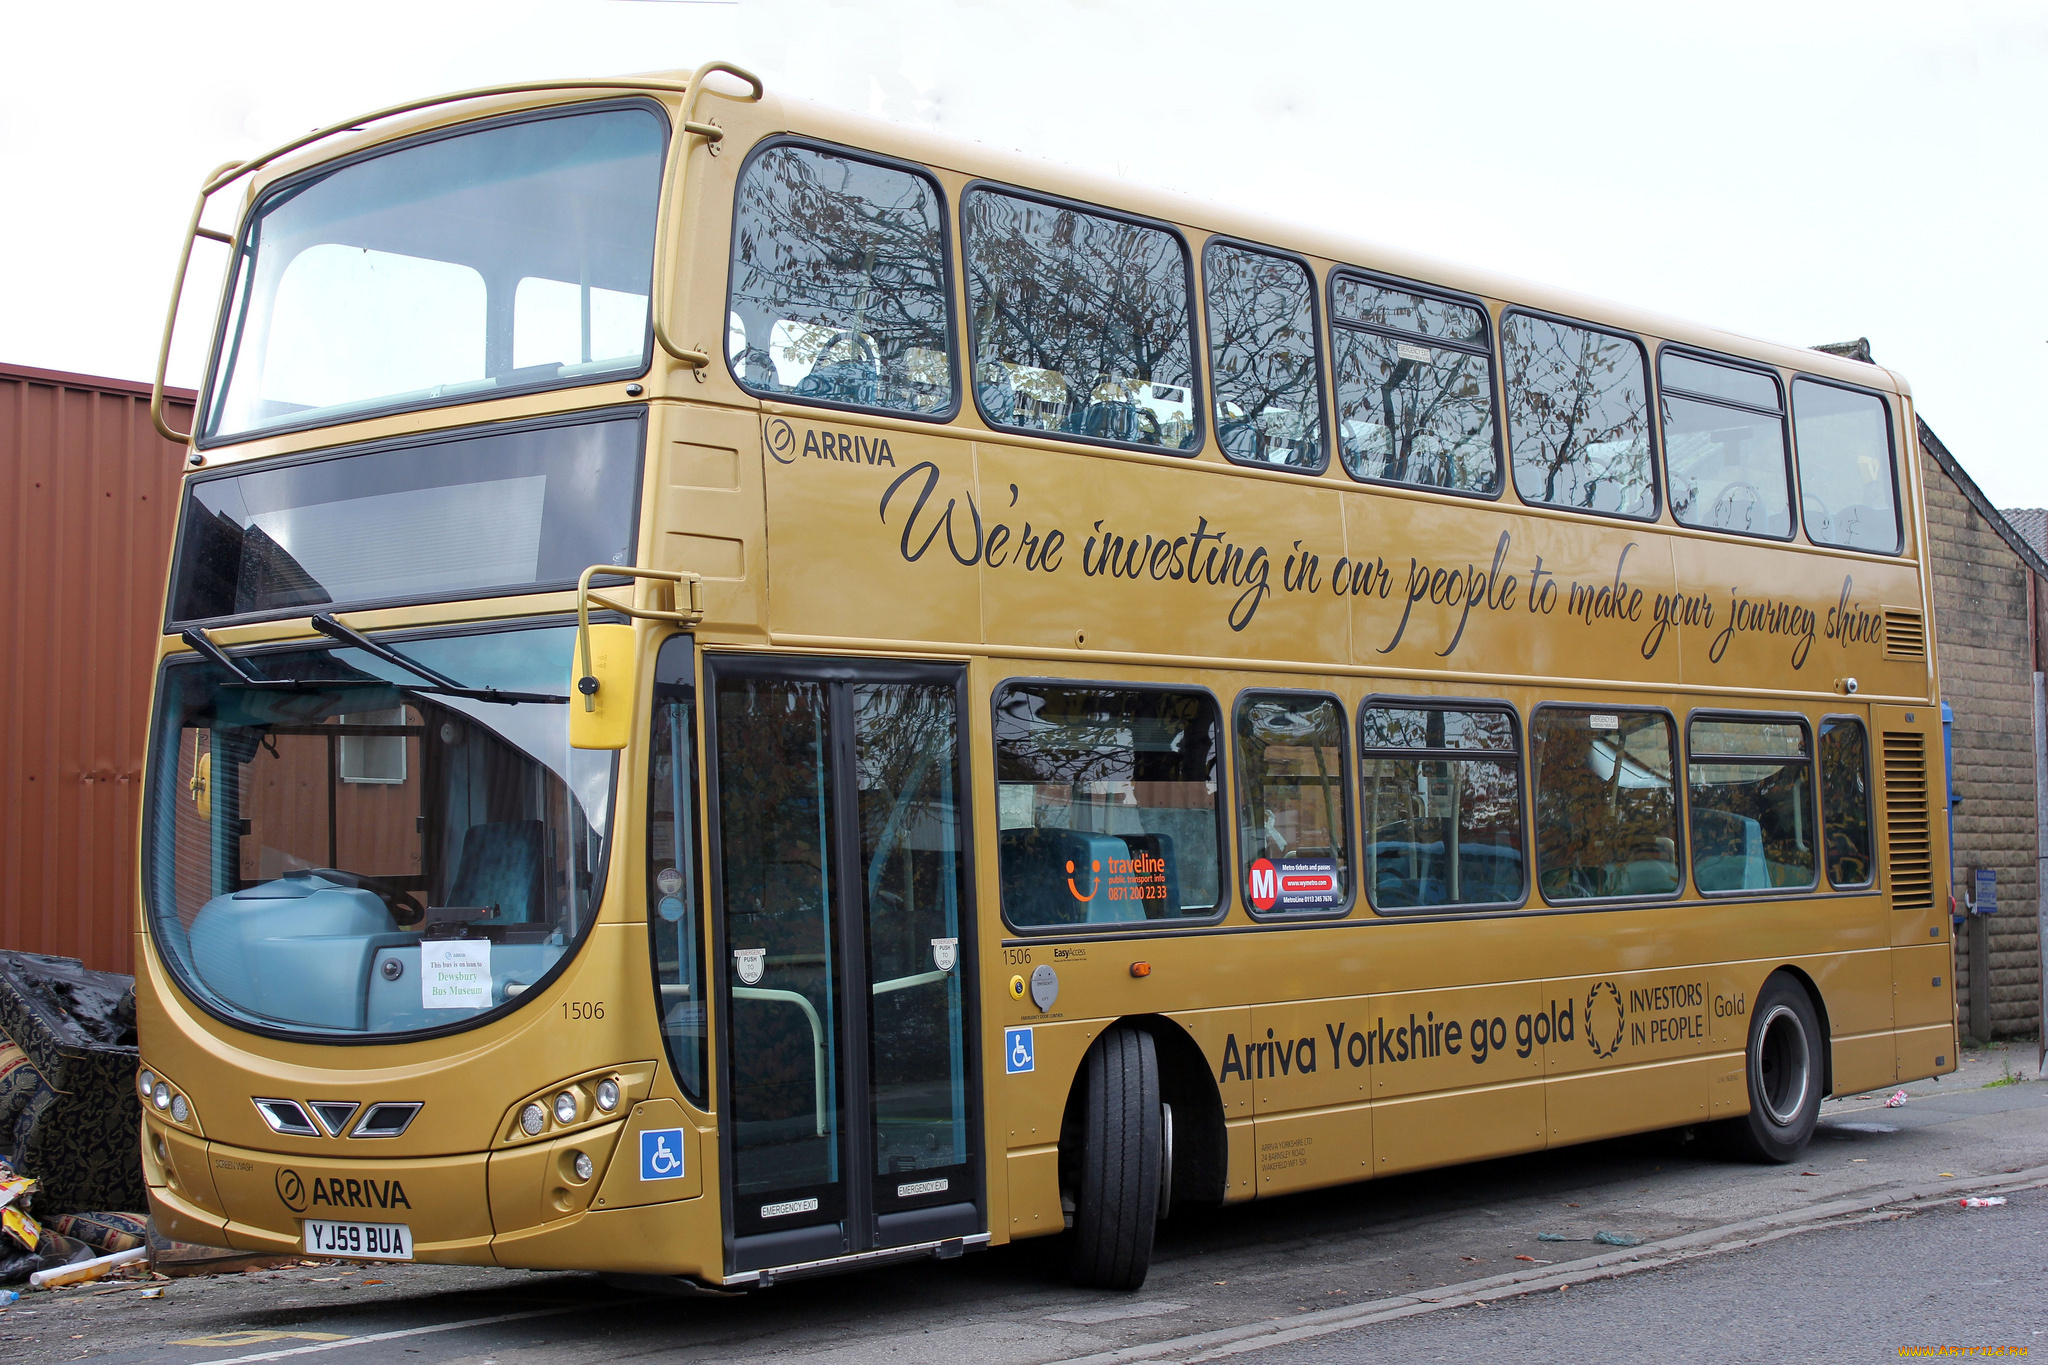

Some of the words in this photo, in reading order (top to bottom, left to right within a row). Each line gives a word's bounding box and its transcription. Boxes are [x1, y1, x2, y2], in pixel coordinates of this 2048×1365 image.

[803, 430, 895, 467] ARRIVA
[879, 461, 1065, 573] We're
[1082, 516, 1272, 632] investing
[1284, 539, 1323, 595] in
[1332, 553, 1394, 599] our
[1376, 530, 1517, 657] people
[1528, 554, 1559, 614] to
[1567, 542, 1643, 626] make
[1641, 588, 1715, 661] your
[1709, 586, 1817, 670] journey
[1824, 575, 1881, 648] shine
[1108, 853, 1165, 874] traveline
[1108, 875, 1126, 886] public
[1127, 875, 1153, 884] transport
[1154, 874, 1166, 882] info
[1252, 869, 1274, 898] M
[1108, 887, 1128, 900] 0871
[1130, 886, 1144, 900] 200
[1146, 886, 1156, 899] 22
[1157, 885, 1167, 898] 33
[1003, 948, 1032, 965] 1506
[1054, 948, 1086, 958] EasyAccess
[438, 972, 477, 983] Dewsbury
[432, 986, 447, 995] Bus
[449, 986, 482, 995] Museum
[1630, 983, 1703, 1014] INVESTORS
[562, 1002, 604, 1020] 1506
[1714, 992, 1746, 1020] Gold
[1630, 1022, 1646, 1046] IN
[1650, 1014, 1704, 1044] PEOPLE
[1220, 1028, 1316, 1084] Arriva
[1326, 1010, 1462, 1069] Yorkshire
[1470, 1018, 1508, 1064] go
[1515, 998, 1575, 1055] gold
[313, 1177, 412, 1210] ARRIVA
[899, 1183, 934, 1196] EMERGENCY
[935, 1180, 947, 1191] EXIT
[762, 1202, 802, 1217] EMERGENCY
[803, 1200, 817, 1210] EXIT
[312, 1224, 360, 1252] YJ59
[366, 1227, 404, 1254] BUA
